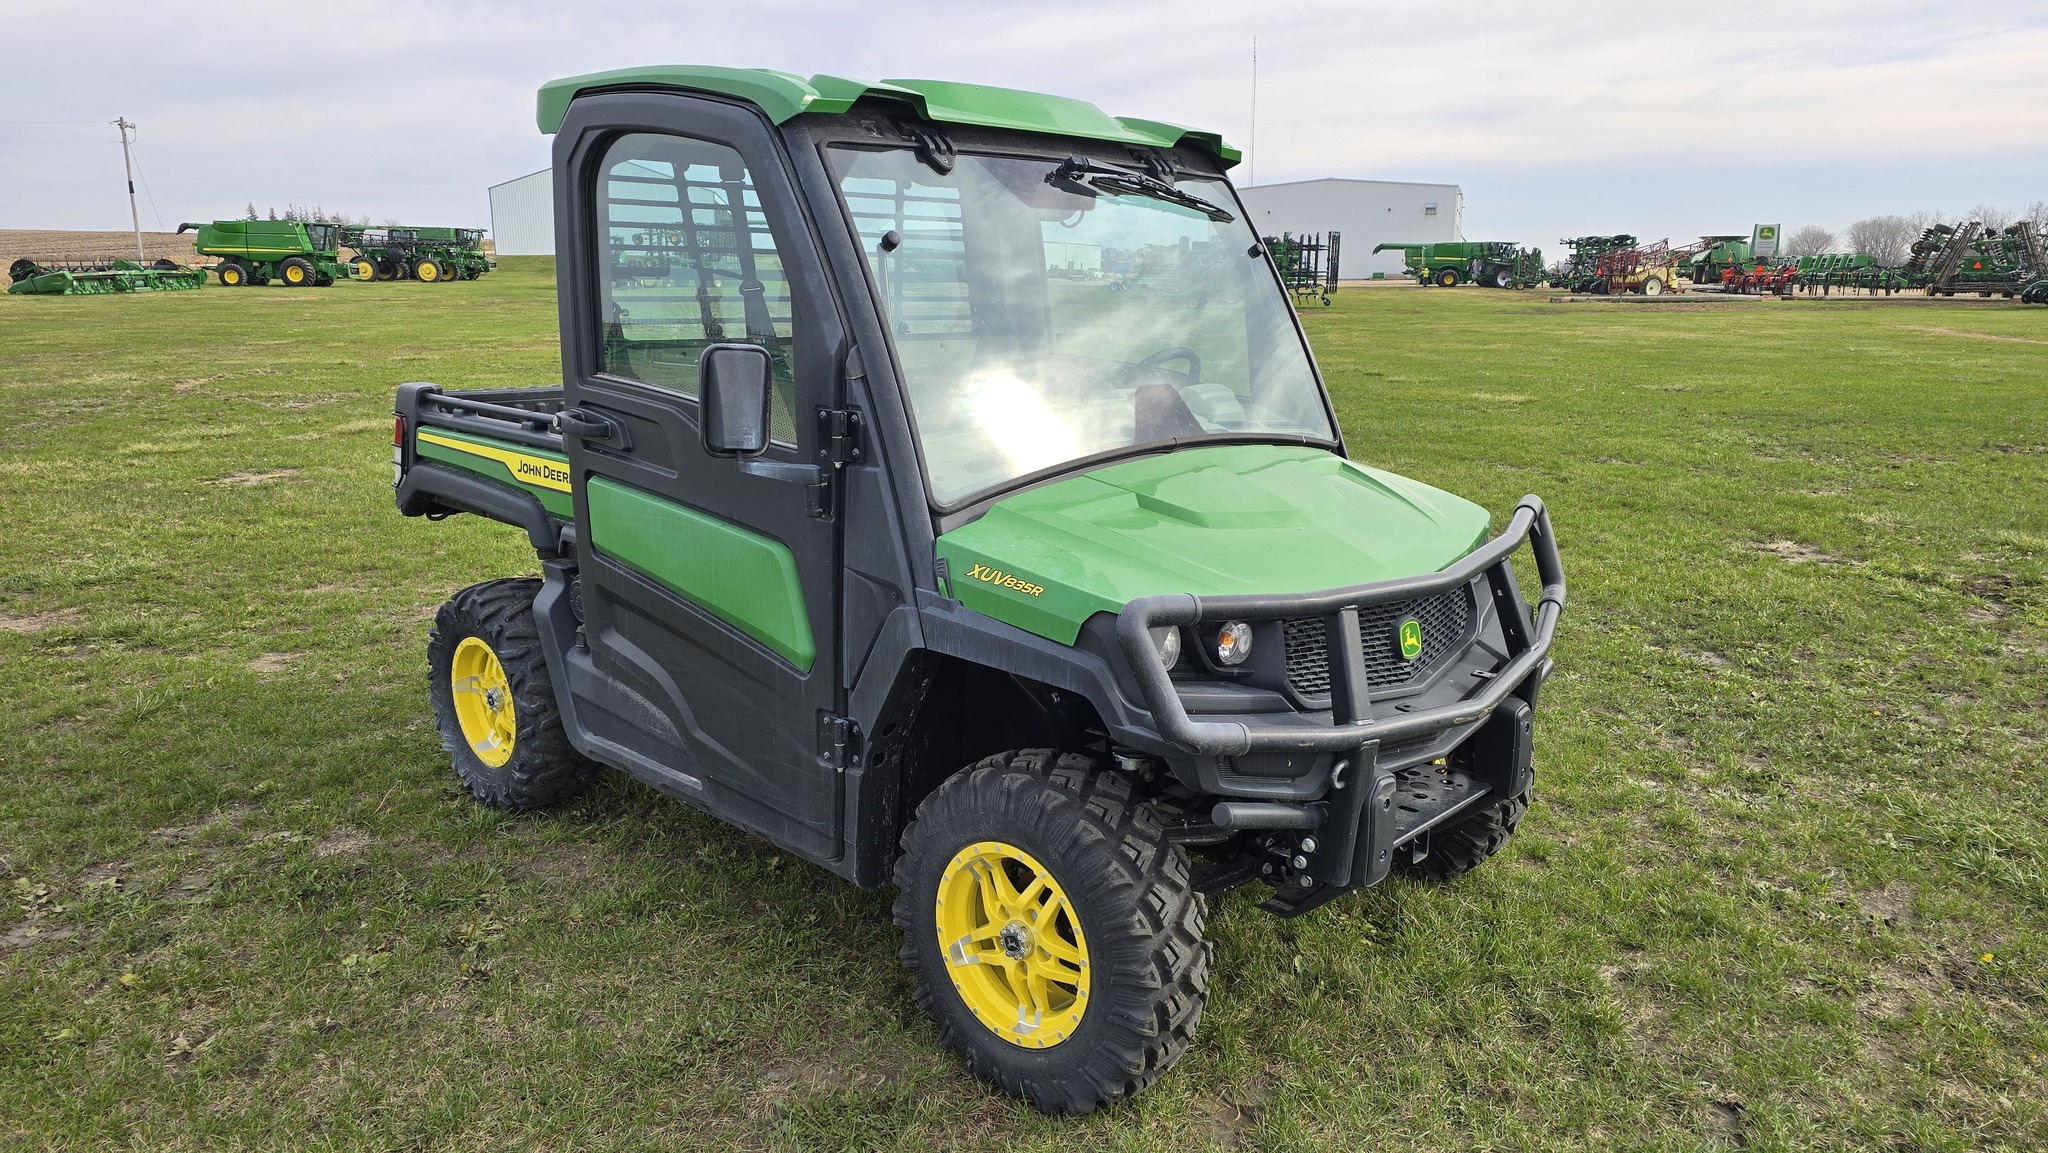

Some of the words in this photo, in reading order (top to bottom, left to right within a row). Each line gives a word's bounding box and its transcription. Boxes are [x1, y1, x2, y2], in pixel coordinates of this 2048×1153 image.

[517, 460, 542, 477] JOHN
[543, 465, 571, 484] DEER
[965, 563, 1046, 597] XUV835R
